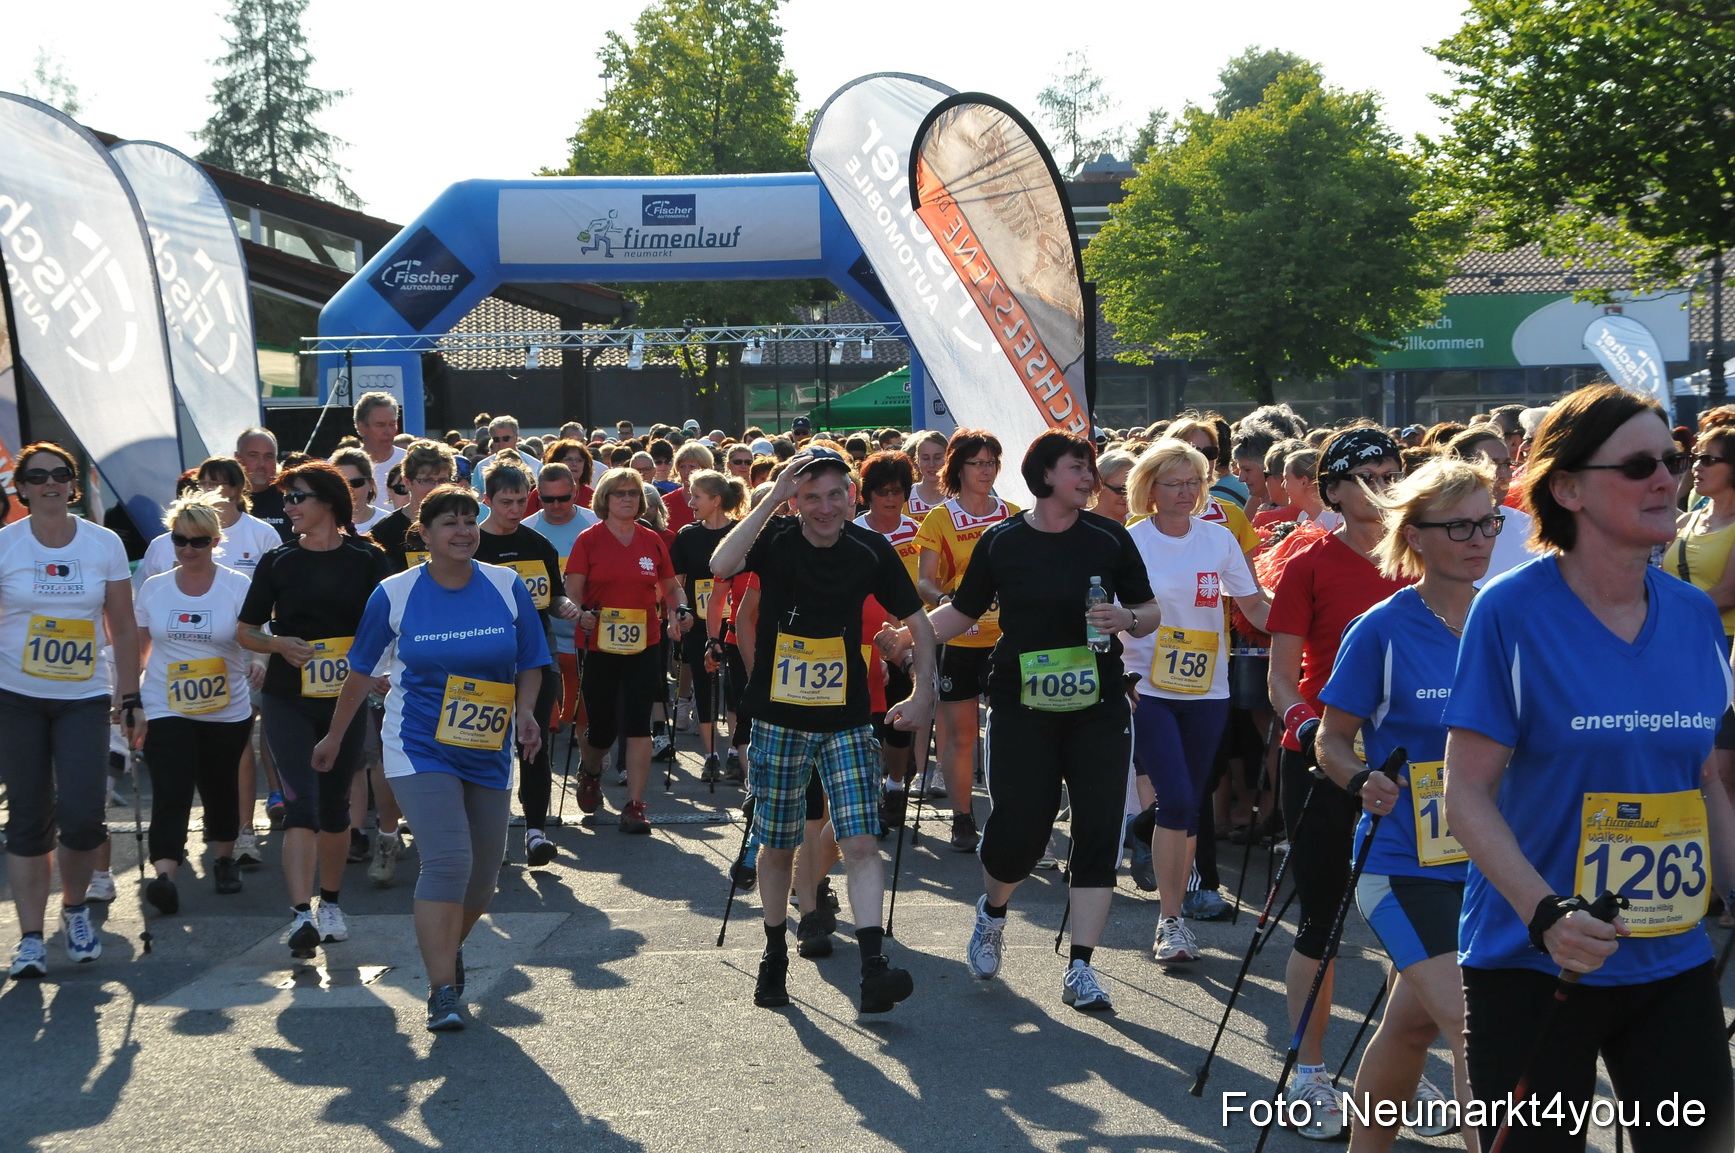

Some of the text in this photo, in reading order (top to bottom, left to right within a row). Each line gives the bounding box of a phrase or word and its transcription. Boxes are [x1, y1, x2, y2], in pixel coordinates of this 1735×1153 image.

[652, 205, 693, 216] Fischer
[624, 225, 743, 249] firmenlauf
[623, 249, 673, 258] neumarkt
[394, 269, 460, 284] Fischer
[956, 530, 983, 543] MAX
[33, 583, 84, 591] POLGER
[414, 627, 505, 642] energiegeladen
[606, 624, 640, 643] 139
[28, 637, 94, 666] 1004
[1165, 649, 1208, 678] 158
[777, 658, 844, 689] 1132
[169, 675, 227, 702] 1002
[1025, 669, 1097, 698] 1085
[445, 700, 507, 733] 1256
[1570, 709, 1717, 733] energiegeladen
[1604, 816, 1661, 829] firmenlauf
[1587, 832, 1634, 844] walken
[1583, 841, 1707, 901] 1263
[1627, 903, 1674, 914] Renate Hilbig
[1631, 917, 1648, 925] und
[1648, 917, 1666, 925] Braun
[1666, 914, 1683, 923] GmbH
